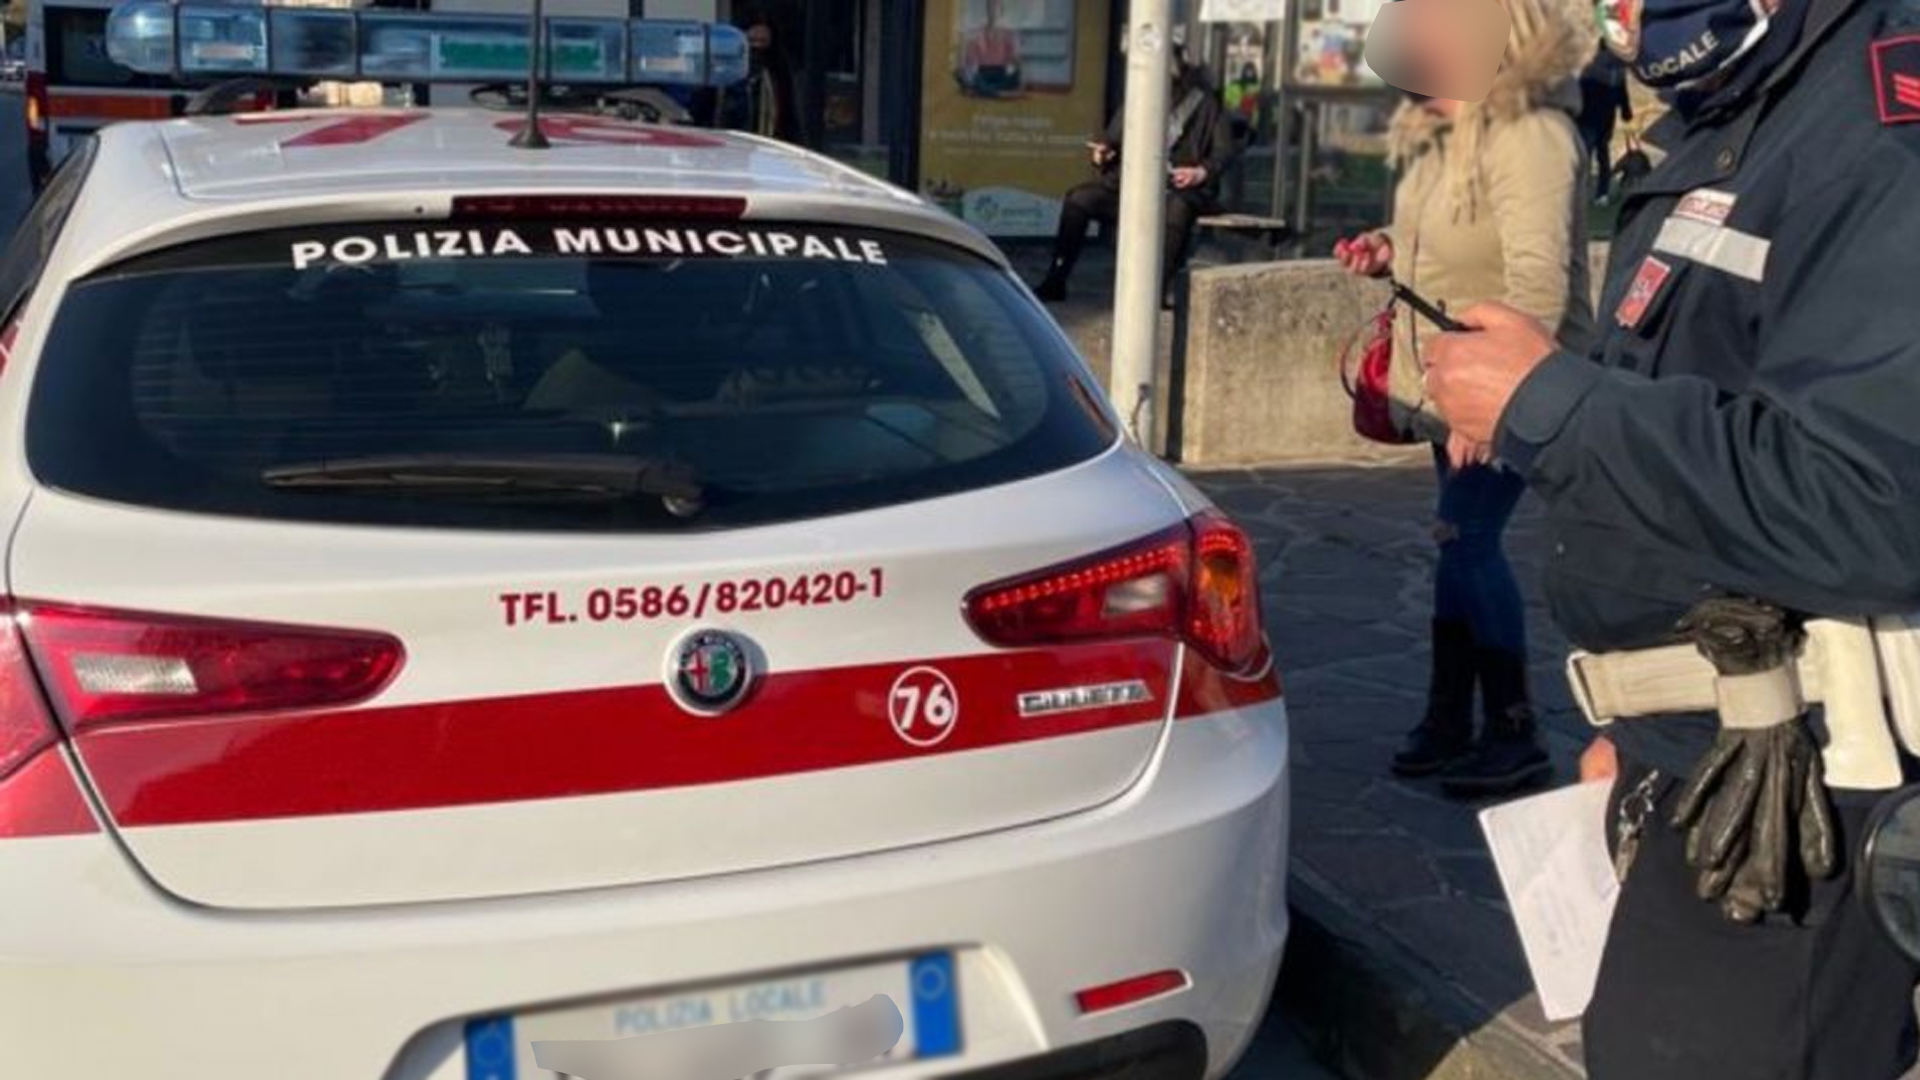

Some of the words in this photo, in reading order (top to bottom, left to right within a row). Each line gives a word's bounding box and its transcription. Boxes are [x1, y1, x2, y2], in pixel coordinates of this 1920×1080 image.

[1638, 30, 1719, 80] LOCALE
[292, 229, 531, 269] POLIZIA
[556, 229, 888, 265] MUNICIPALE
[588, 568, 884, 619] 0586/820420-1
[896, 684, 952, 730] 76
[613, 999, 712, 1035] POLIZIA
[729, 979, 827, 1021] LOCALE
